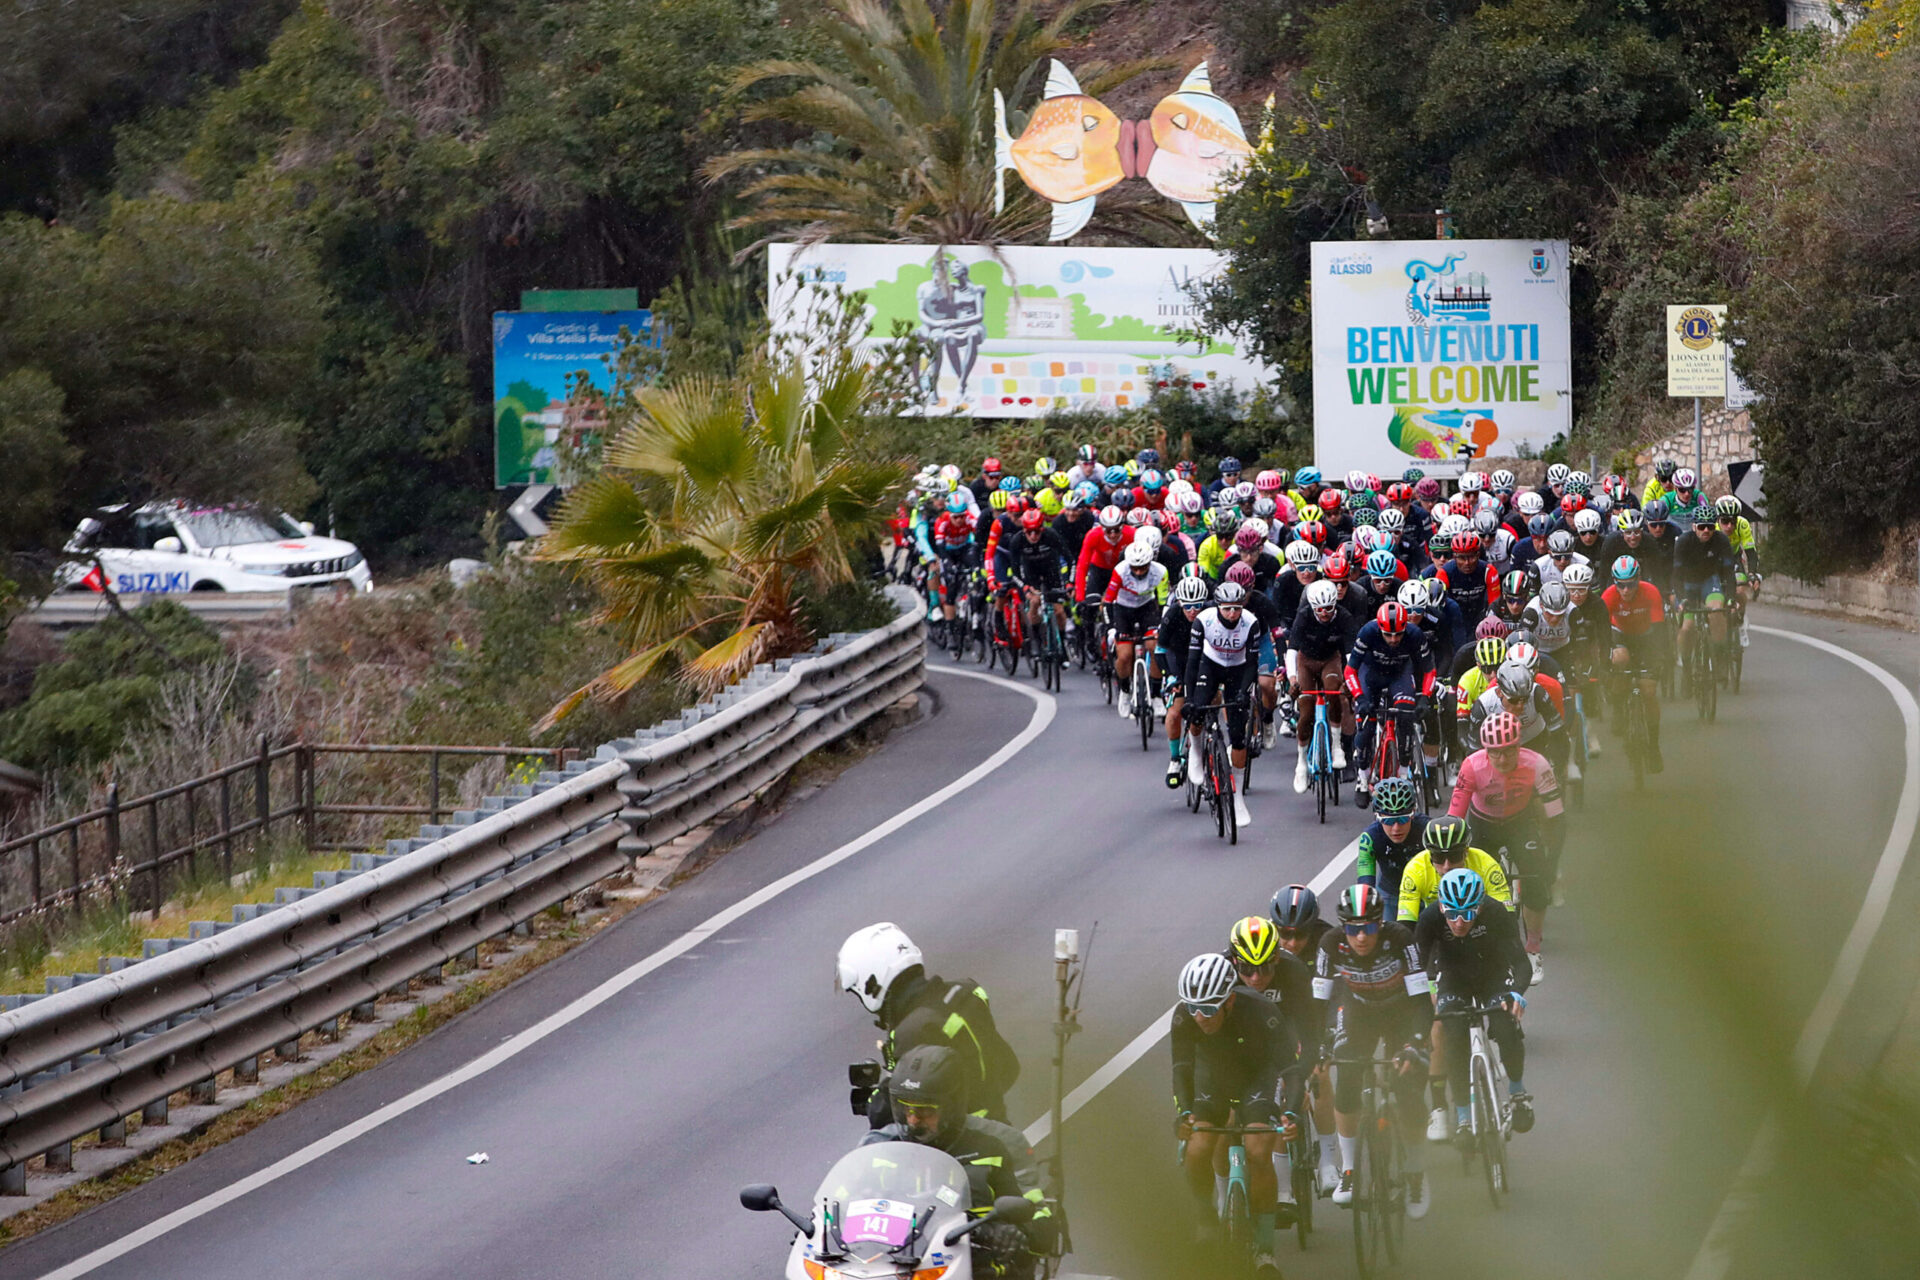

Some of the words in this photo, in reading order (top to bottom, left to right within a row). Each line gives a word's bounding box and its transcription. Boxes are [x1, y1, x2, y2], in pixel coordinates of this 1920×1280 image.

[1329, 263, 1372, 275] ALASSIO
[527, 333, 554, 344] Villa
[1347, 324, 1539, 363] BENVENUTI
[1347, 364, 1539, 404] WELCOME
[118, 571, 190, 594] SUZUKI
[1213, 638, 1241, 649] UAE
[1350, 960, 1401, 982] BIESSE
[863, 1215, 889, 1234] 141
